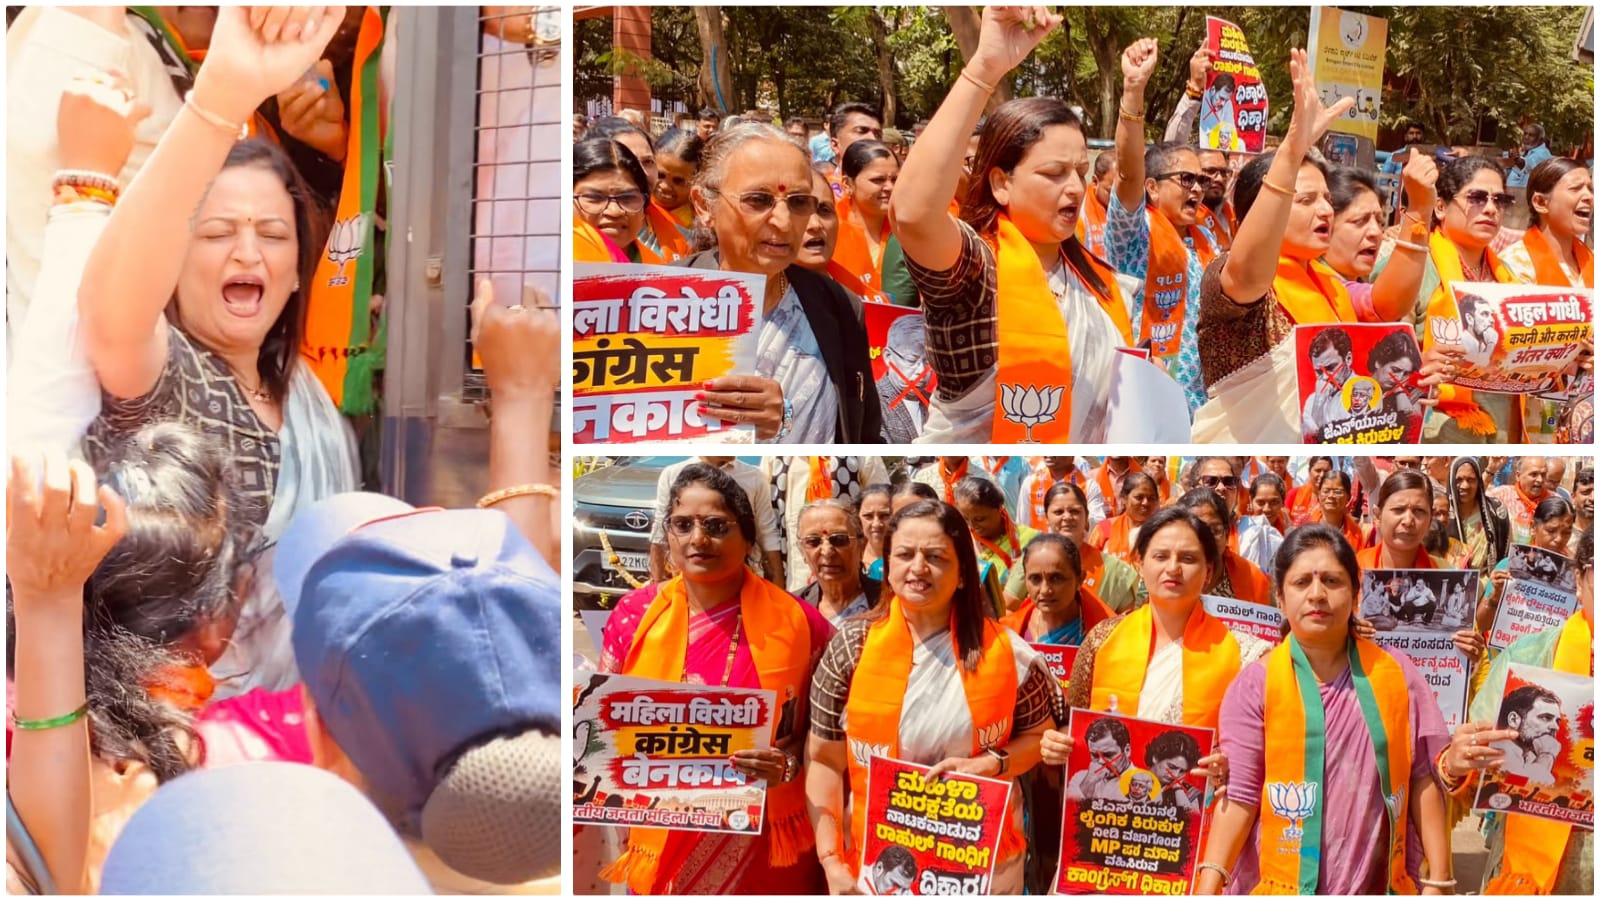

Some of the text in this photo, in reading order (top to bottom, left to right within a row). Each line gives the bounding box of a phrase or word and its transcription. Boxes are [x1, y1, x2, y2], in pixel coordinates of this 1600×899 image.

[628, 285, 742, 333] विरोधी
[1506, 296, 1586, 328] राहुल गांधी,
[1510, 326, 1589, 345] कथनी और करनी में
[1512, 344, 1578, 364] अंतर क्यों?
[1217, 604, 1254, 617] ರಾಹುಲ್
[1411, 637, 1454, 650] ಸಂಸದನ
[610, 696, 761, 726] महिला विरोधी
[635, 727, 732, 755] कांग्रेस
[607, 806, 644, 822] जनता
[890, 790, 985, 822] ಸುರಕ್ಷತೆಯ
[886, 808, 981, 841] ನಾಟಕವಾಡುವ
[1079, 810, 1184, 835] ಲೈಂಗಿಕ ಕಿರುಕುಳ
[876, 823, 991, 870] ರಾಹುಲ್ ಗಾಂಧಿಗೆ
[1090, 838, 1121, 855] MP
[1121, 843, 1141, 857] ಪರ
[1092, 827, 1182, 848] ನೀಡಿ ವಜಾಗೊಂಡ
[1104, 855, 1160, 872] ವಹಿಸಿರುವ
[1067, 866, 1139, 890] ಕಾಂಗ್ರೆಸ್‌ಗೆ
